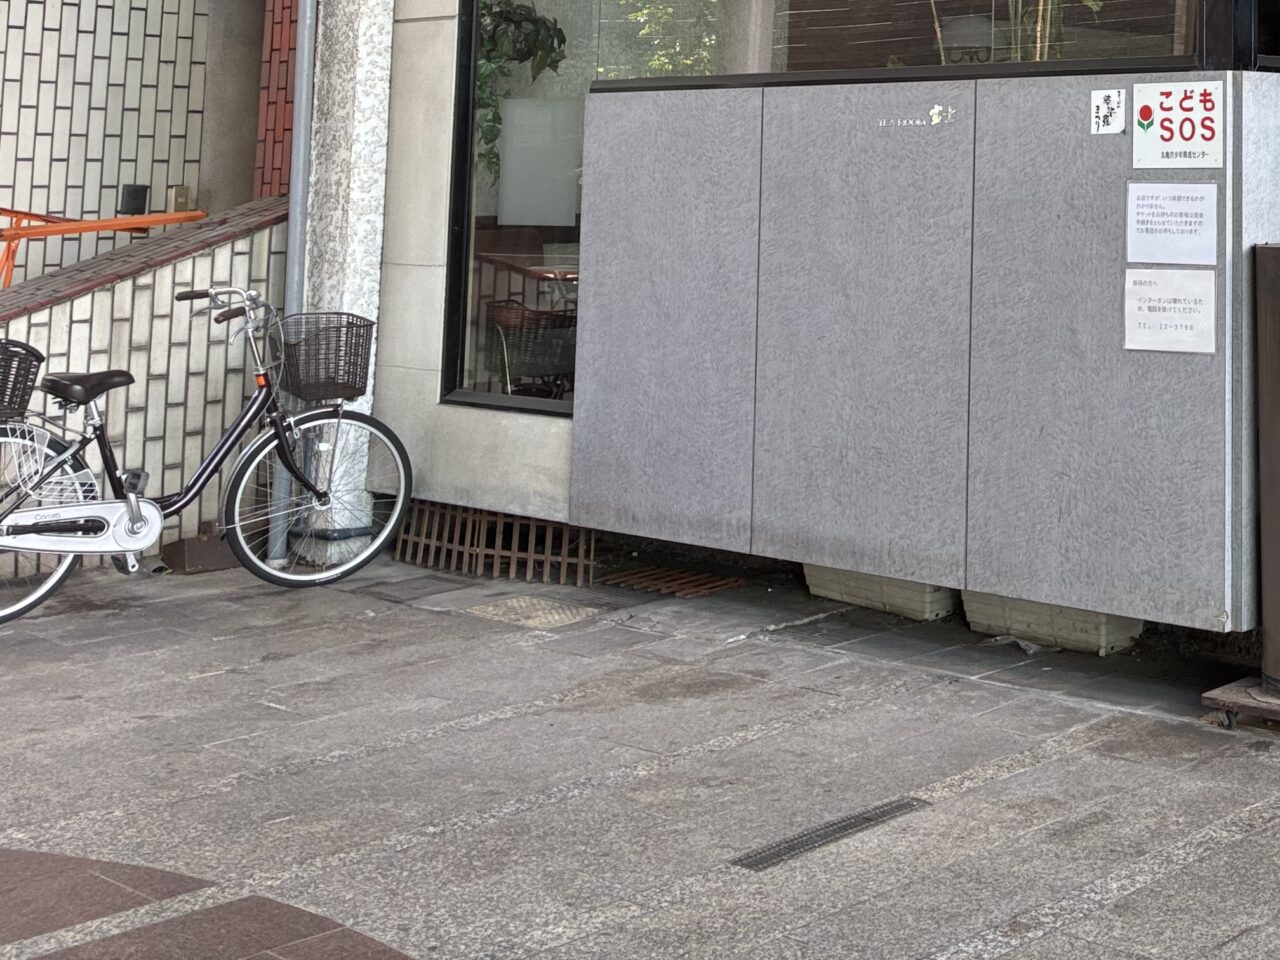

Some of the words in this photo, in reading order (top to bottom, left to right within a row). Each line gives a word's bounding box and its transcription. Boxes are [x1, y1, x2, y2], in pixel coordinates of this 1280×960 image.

[1159, 88, 1215, 112] こども
[1159, 116, 1216, 142] SOS
